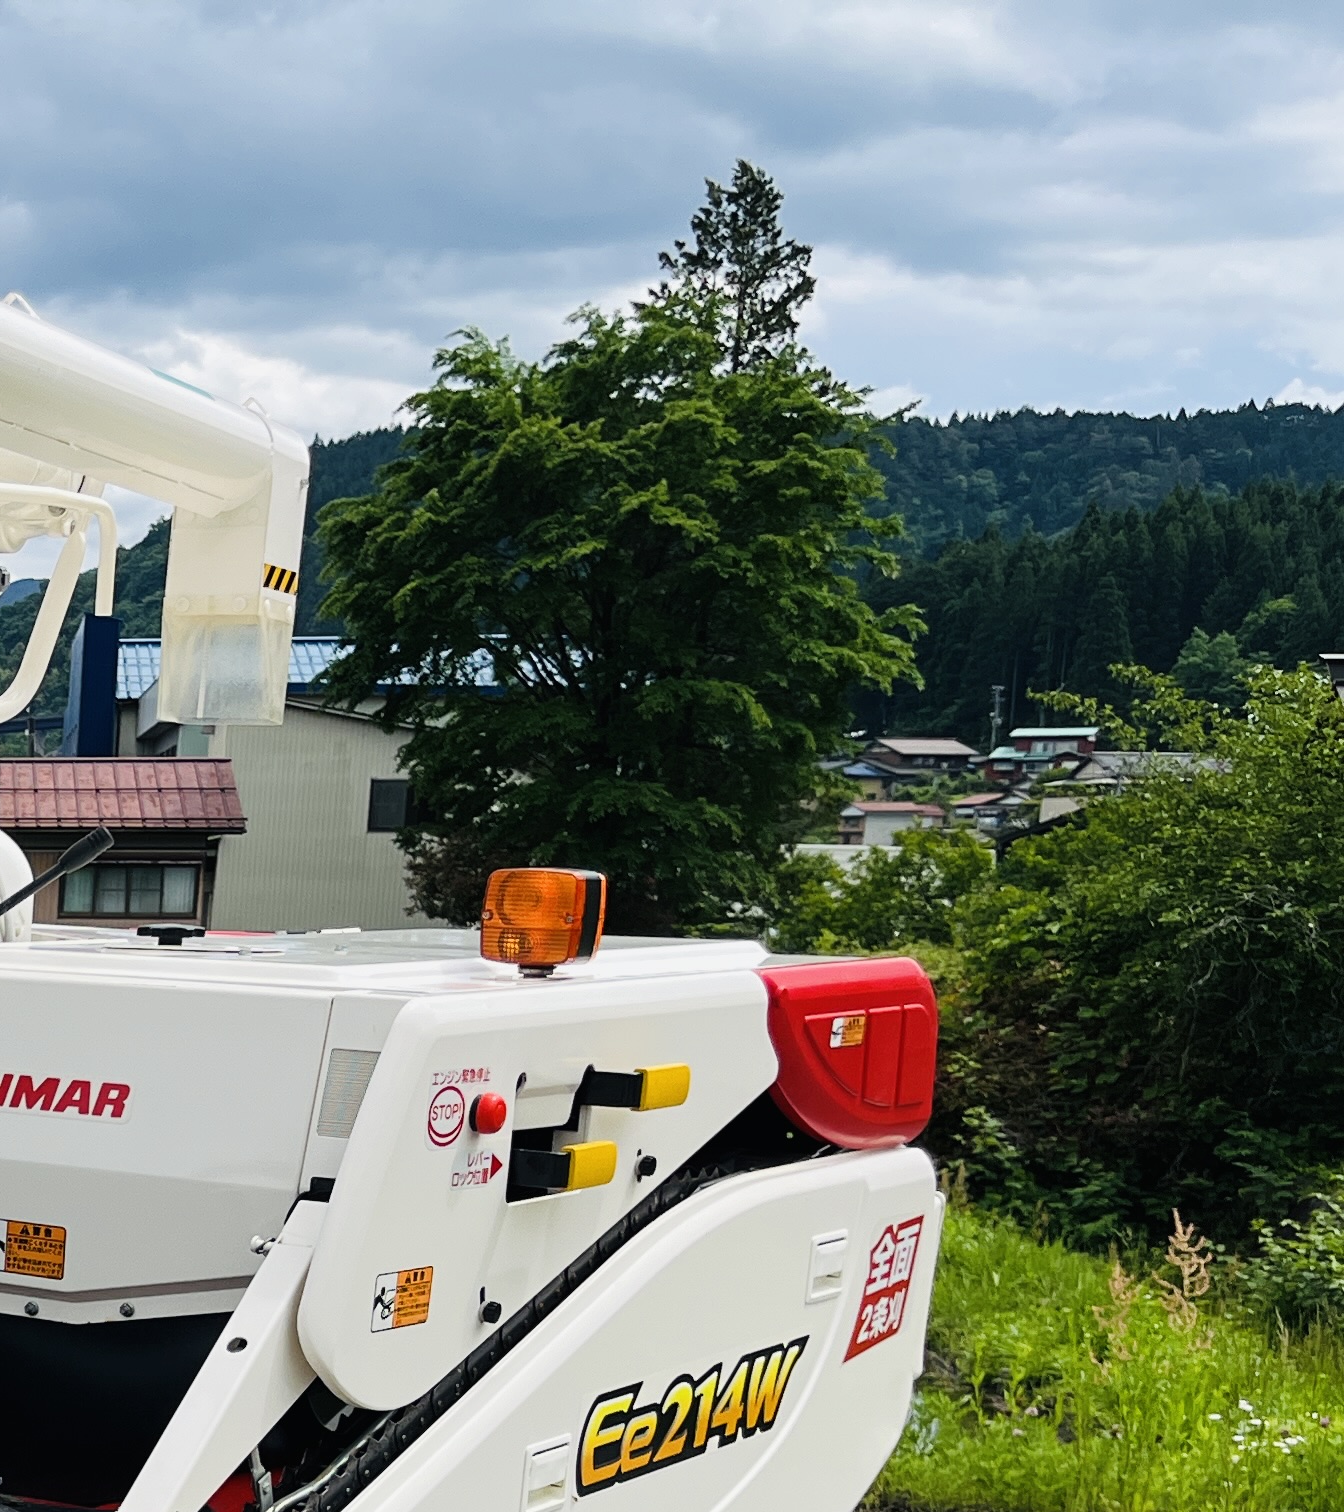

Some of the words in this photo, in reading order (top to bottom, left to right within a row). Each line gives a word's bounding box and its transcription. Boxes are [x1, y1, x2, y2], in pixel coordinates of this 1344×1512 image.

[431, 1067, 491, 1086] エンジン緊急停止
[431, 1102, 462, 1122] STOP!
[467, 1151, 491, 1168] レバー
[451, 1167, 490, 1187] ロック位置
[865, 1223, 921, 1296] 全面
[856, 1287, 907, 1345] 2条刈
[578, 1340, 806, 1492] Ee214W
